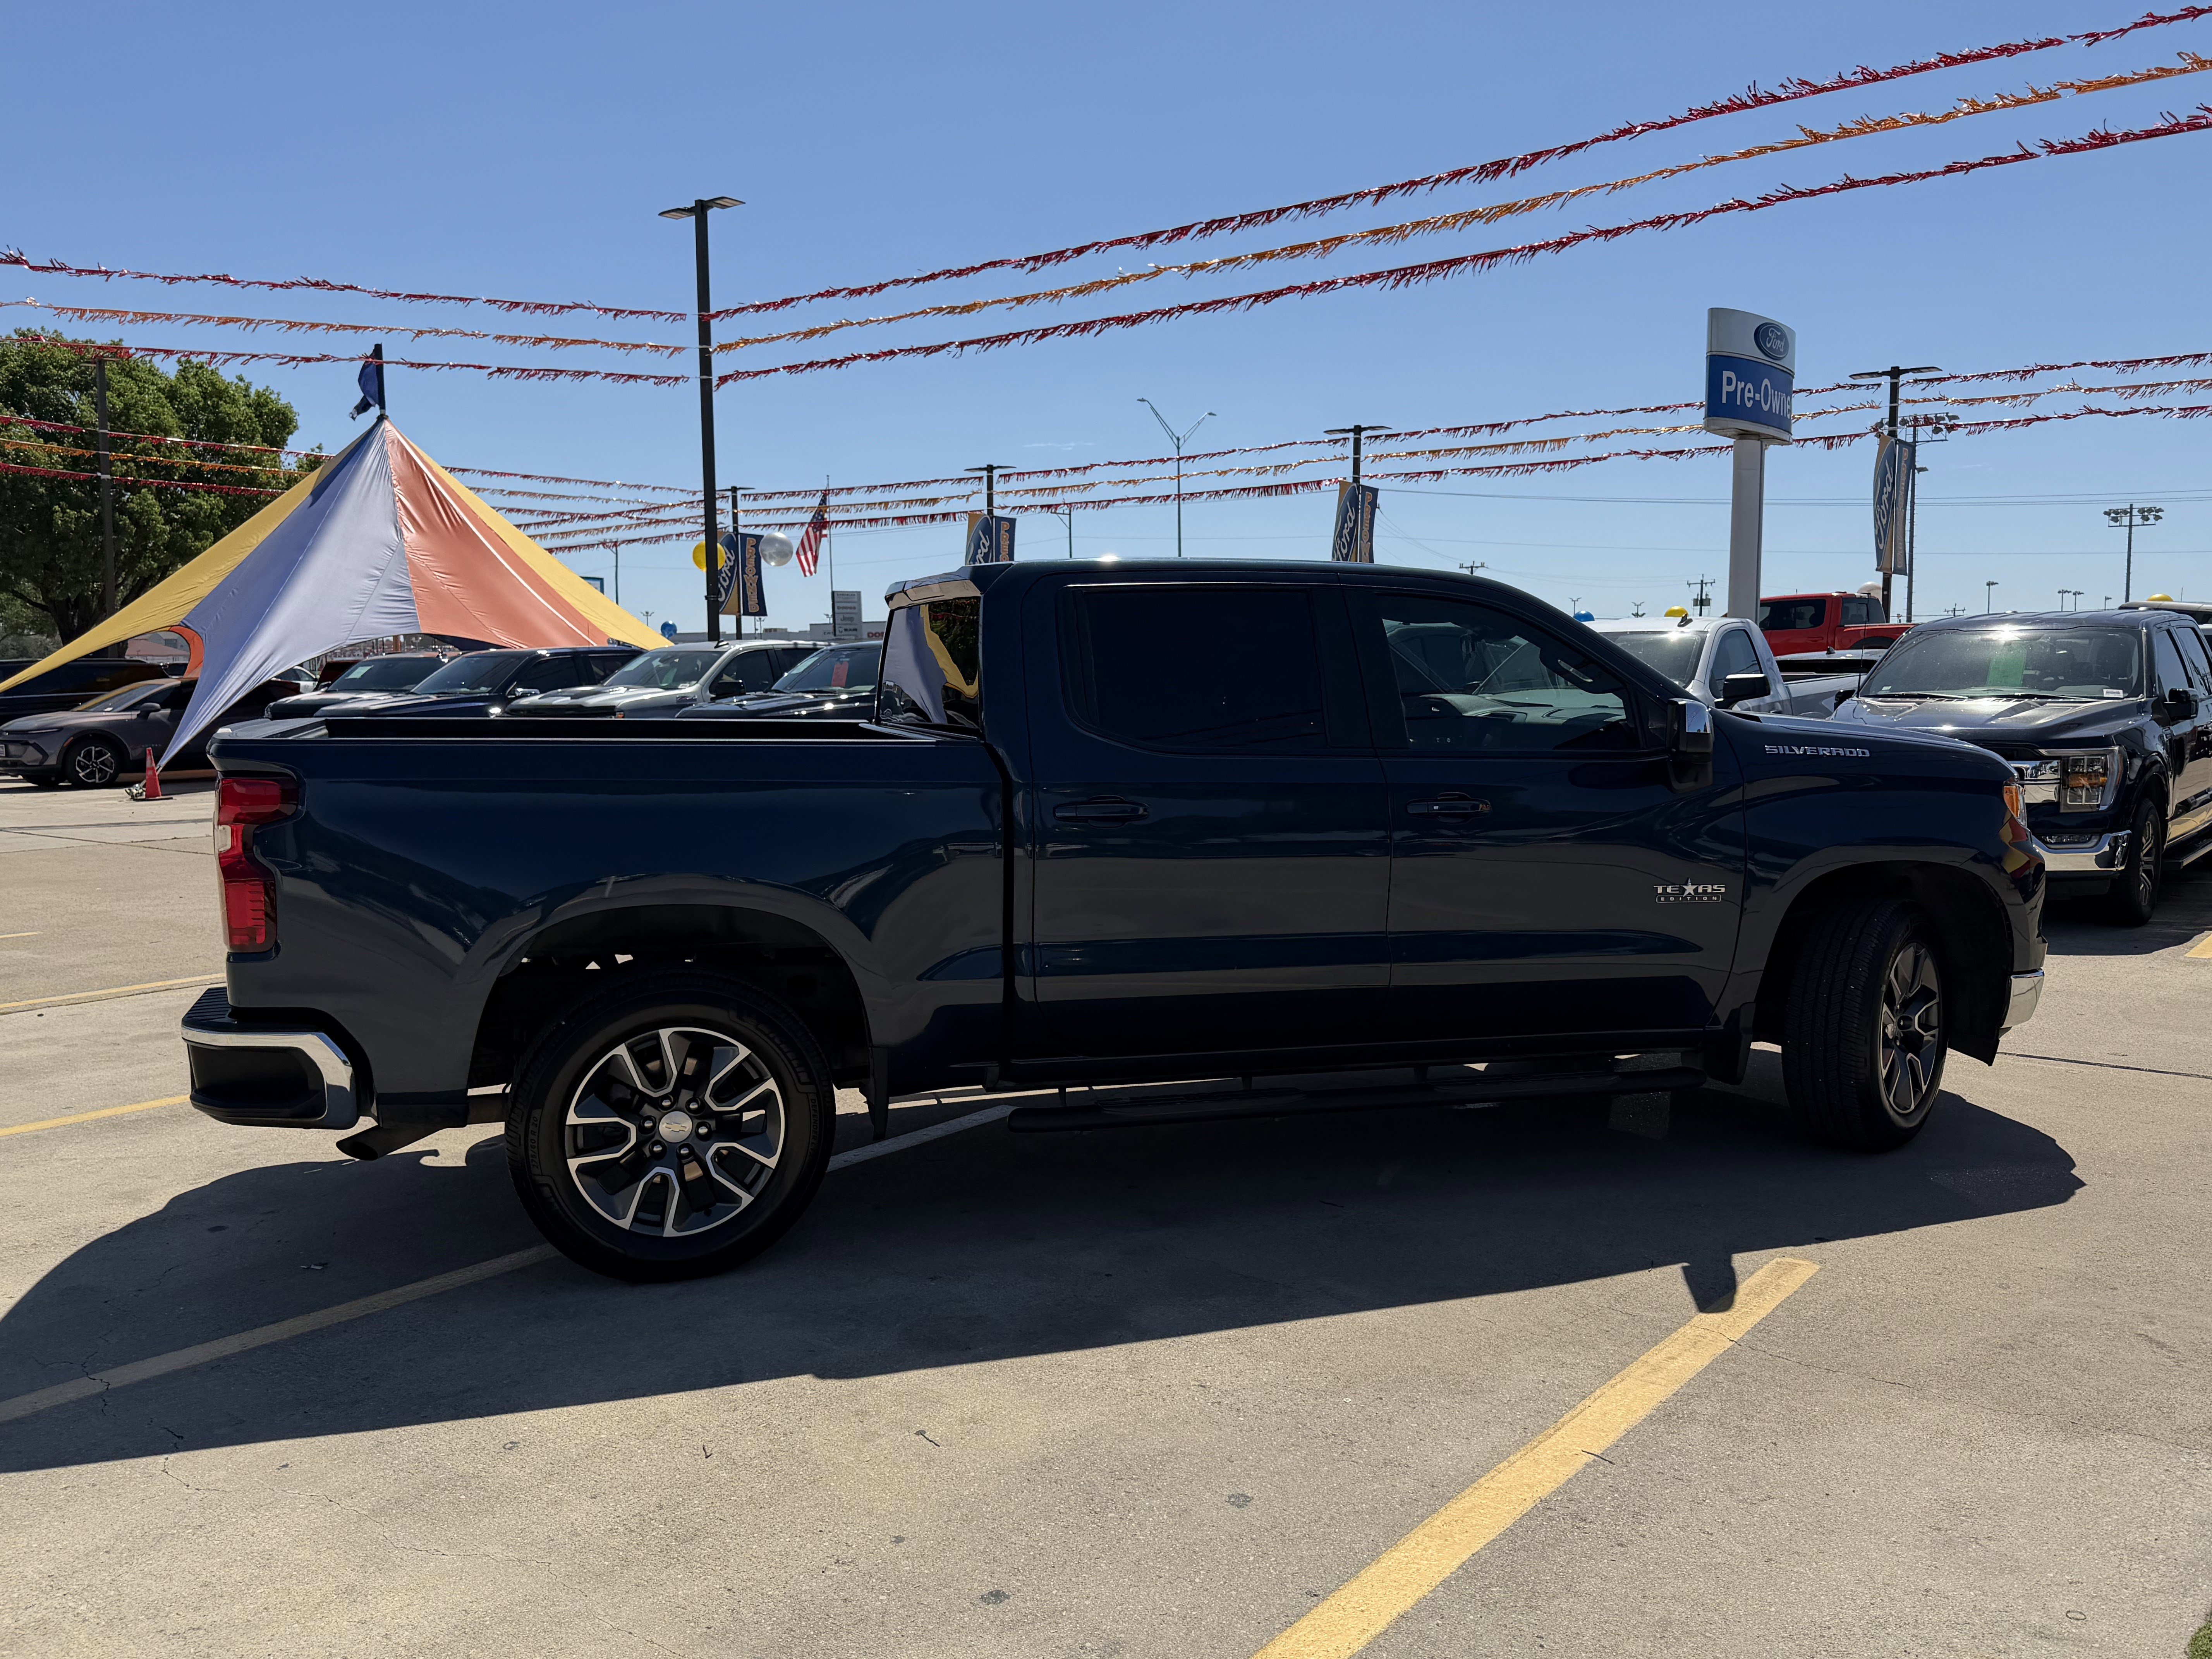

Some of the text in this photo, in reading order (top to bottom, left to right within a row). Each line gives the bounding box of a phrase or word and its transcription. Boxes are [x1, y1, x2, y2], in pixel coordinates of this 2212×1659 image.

[1766, 328, 1785, 352] Ford
[744, 537, 759, 612] PREOWNED
[1765, 745, 1870, 757] SILVERADO
